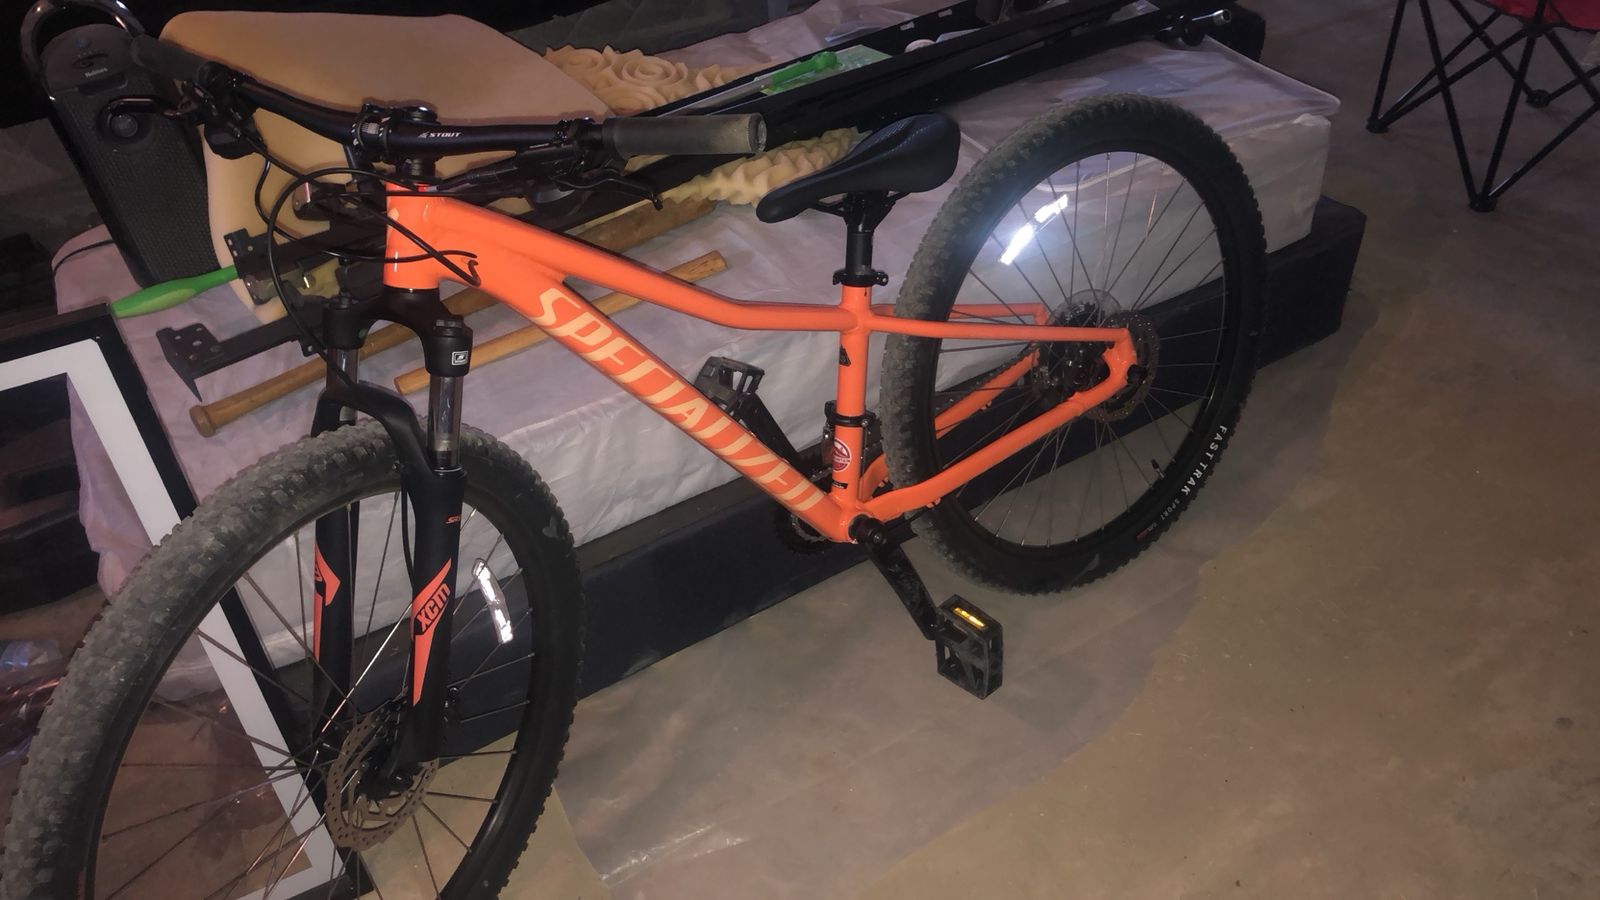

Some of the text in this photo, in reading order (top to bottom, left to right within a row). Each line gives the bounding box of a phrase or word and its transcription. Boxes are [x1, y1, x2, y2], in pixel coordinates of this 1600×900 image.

[1160, 425, 1228, 520] FAST TRAK SPORT
